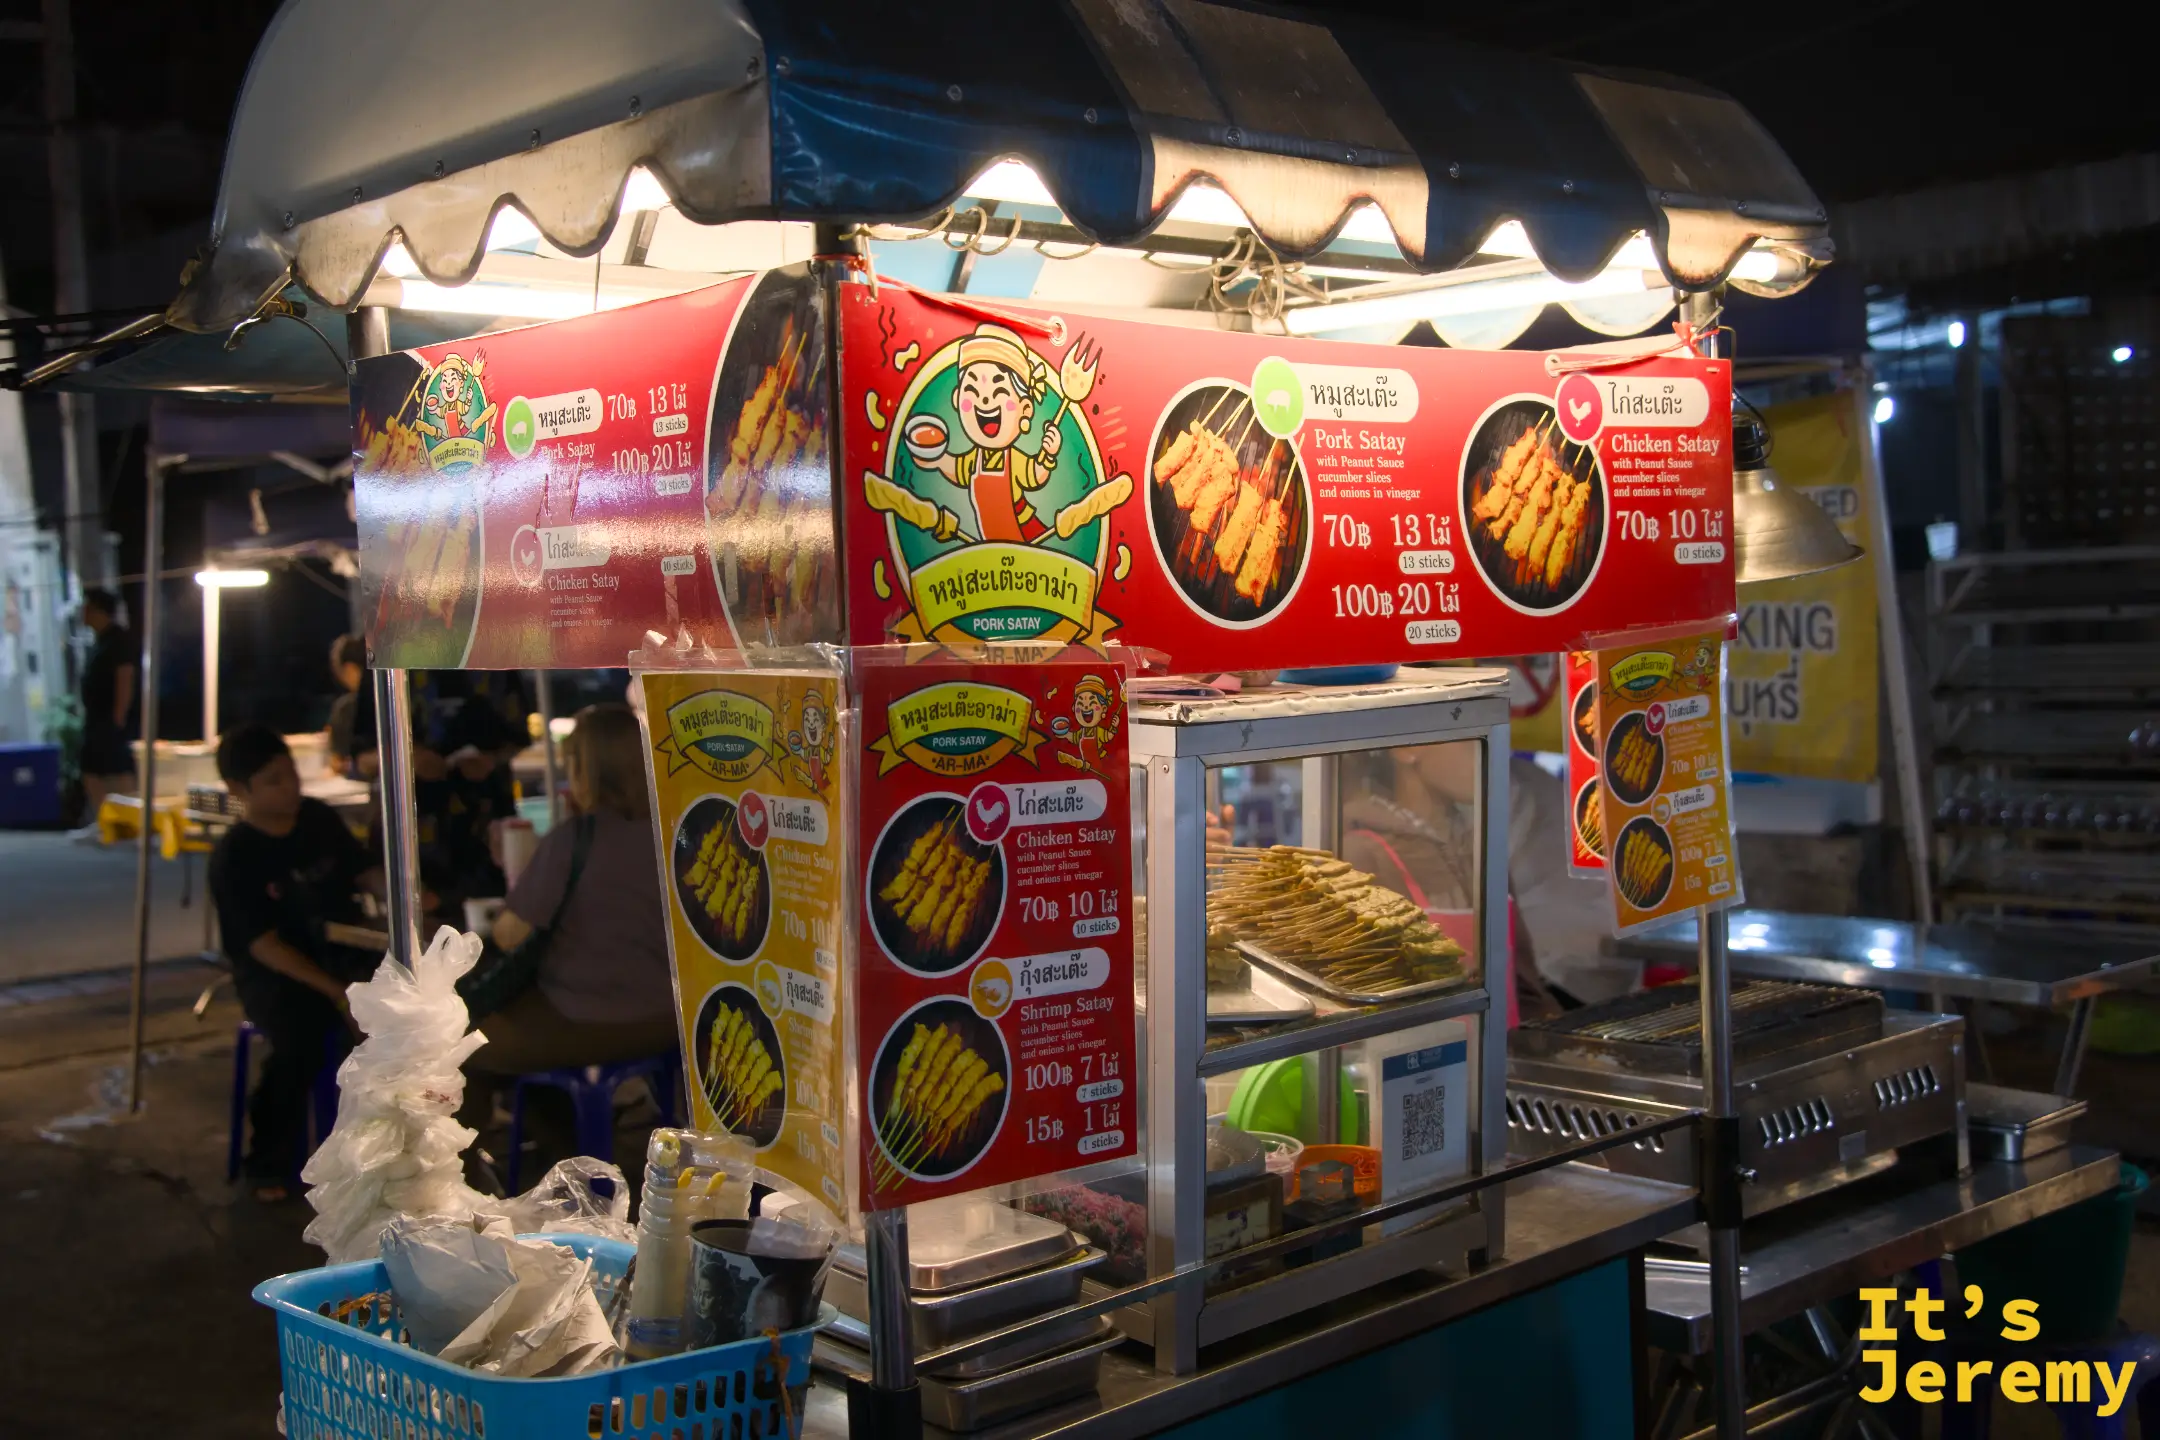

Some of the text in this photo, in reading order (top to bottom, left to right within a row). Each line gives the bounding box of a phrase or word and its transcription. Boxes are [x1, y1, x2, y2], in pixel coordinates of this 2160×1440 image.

[607, 383, 687, 421] 70฿ 13 ไม้
[1310, 375, 1398, 418] หมูสะเต๊ะ
[1608, 381, 1682, 415] ไก่สะเต๊ะ
[538, 396, 591, 436] หมูสะเต๊ะ
[655, 417, 686, 433] 13 sticks
[567, 441, 596, 459] Satay
[1314, 428, 1406, 455] Pork Satay
[1611, 433, 1720, 456] Chicken Satay
[611, 441, 691, 477] 100฿ 20 ไม้
[1316, 455, 1405, 468] with Peanut Sauce
[1612, 457, 1693, 469] with Peanut Sauce
[1318, 470, 1392, 483] cucumber slices
[1613, 471, 1680, 483] cucumber slices
[1320, 486, 1421, 500] and onions in vinegar
[1614, 485, 1706, 498] and onions in vinegar
[1323, 513, 1451, 550] 70฿ 13 ไม้
[1616, 508, 1724, 543] 70฿ 10 ไม้
[1677, 545, 1722, 559] 10 sticks
[663, 561, 672, 572] 10
[1403, 554, 1450, 569] 13 sticks
[550, 573, 620, 591] Chicken Satay
[1331, 581, 1460, 619] 100฿ 20 ไม้
[973, 617, 1041, 631] PORK SATAY
[1408, 624, 1457, 639] 20 sticks
[706, 742, 745, 752] PORK SATAY
[932, 736, 986, 747] PORK SATAY
[1015, 786, 1084, 816] ไก่สะเต๊ะ
[769, 800, 816, 833] ไก่สะเต๊ะ
[1017, 827, 1117, 848] Chicken Satay
[1017, 848, 1092, 863] with Peanut Sauce
[1017, 861, 1080, 874] cucumber slices
[1017, 871, 1104, 887] and onions in vinegar
[1019, 889, 1119, 923] 70฿ 10 ไม้
[1076, 919, 1117, 935] 10 sticks
[1020, 952, 1088, 994] กุ้งสะเต๊ะ
[1020, 996, 1115, 1022] Shrimp Satay
[1020, 1016, 1095, 1036] with Peanut Sauce
[1020, 1030, 1083, 1048] cucumber slices
[1020, 1037, 1107, 1060] and onions in vinegar
[1024, 1051, 1119, 1092] 100฿ 7 ไม้
[1081, 1082, 1118, 1099] 7 sticks
[1025, 1102, 1120, 1144] 15฿ 1 ไม้
[1083, 1134, 1119, 1150] 1 sticks
